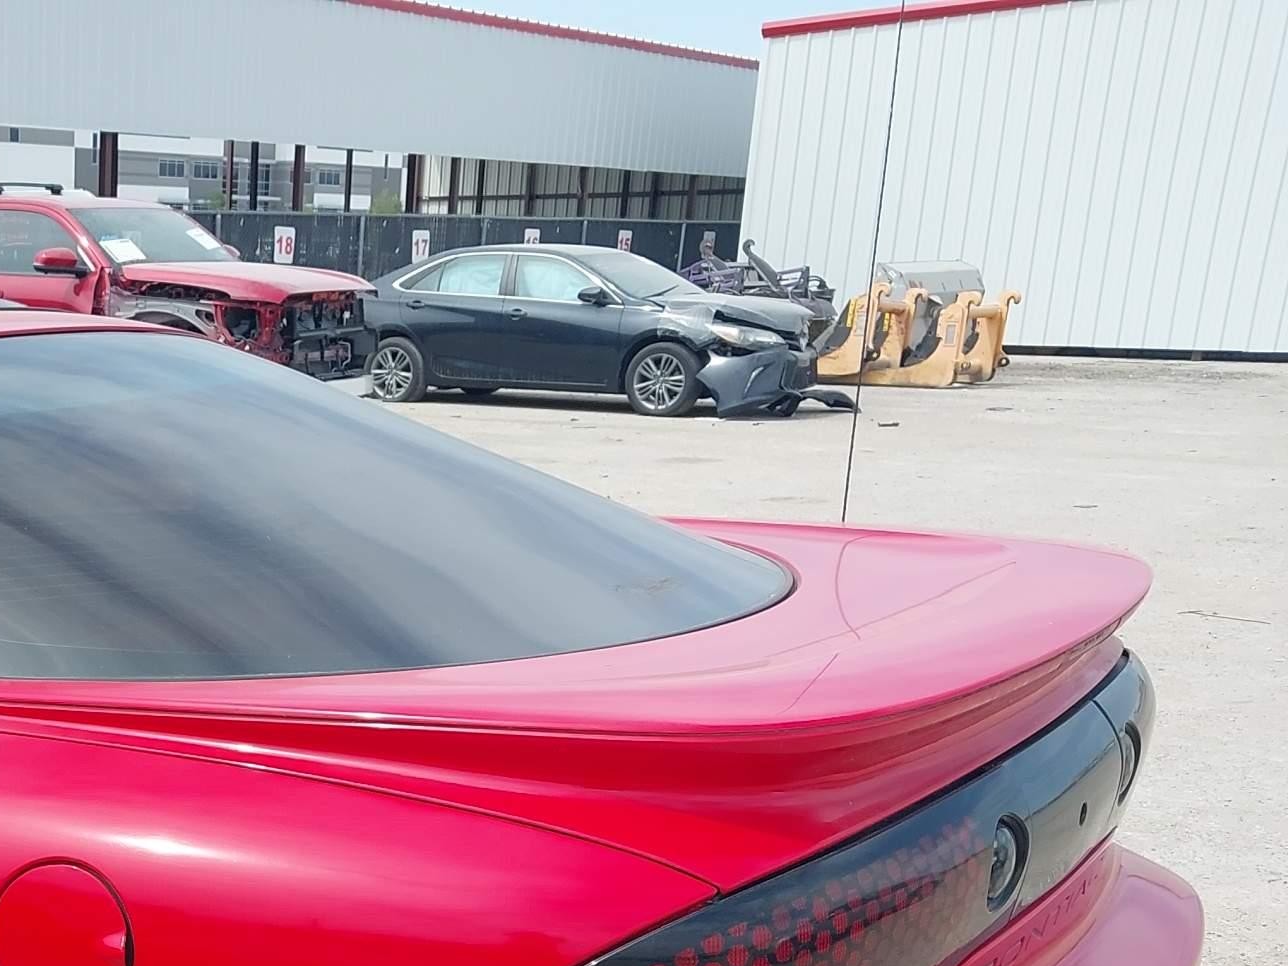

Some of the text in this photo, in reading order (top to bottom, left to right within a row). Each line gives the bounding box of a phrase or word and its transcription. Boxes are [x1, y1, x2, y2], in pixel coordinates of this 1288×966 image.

[276, 235, 293, 255] 18
[414, 238, 429, 256] 17
[619, 236, 631, 252] 15
